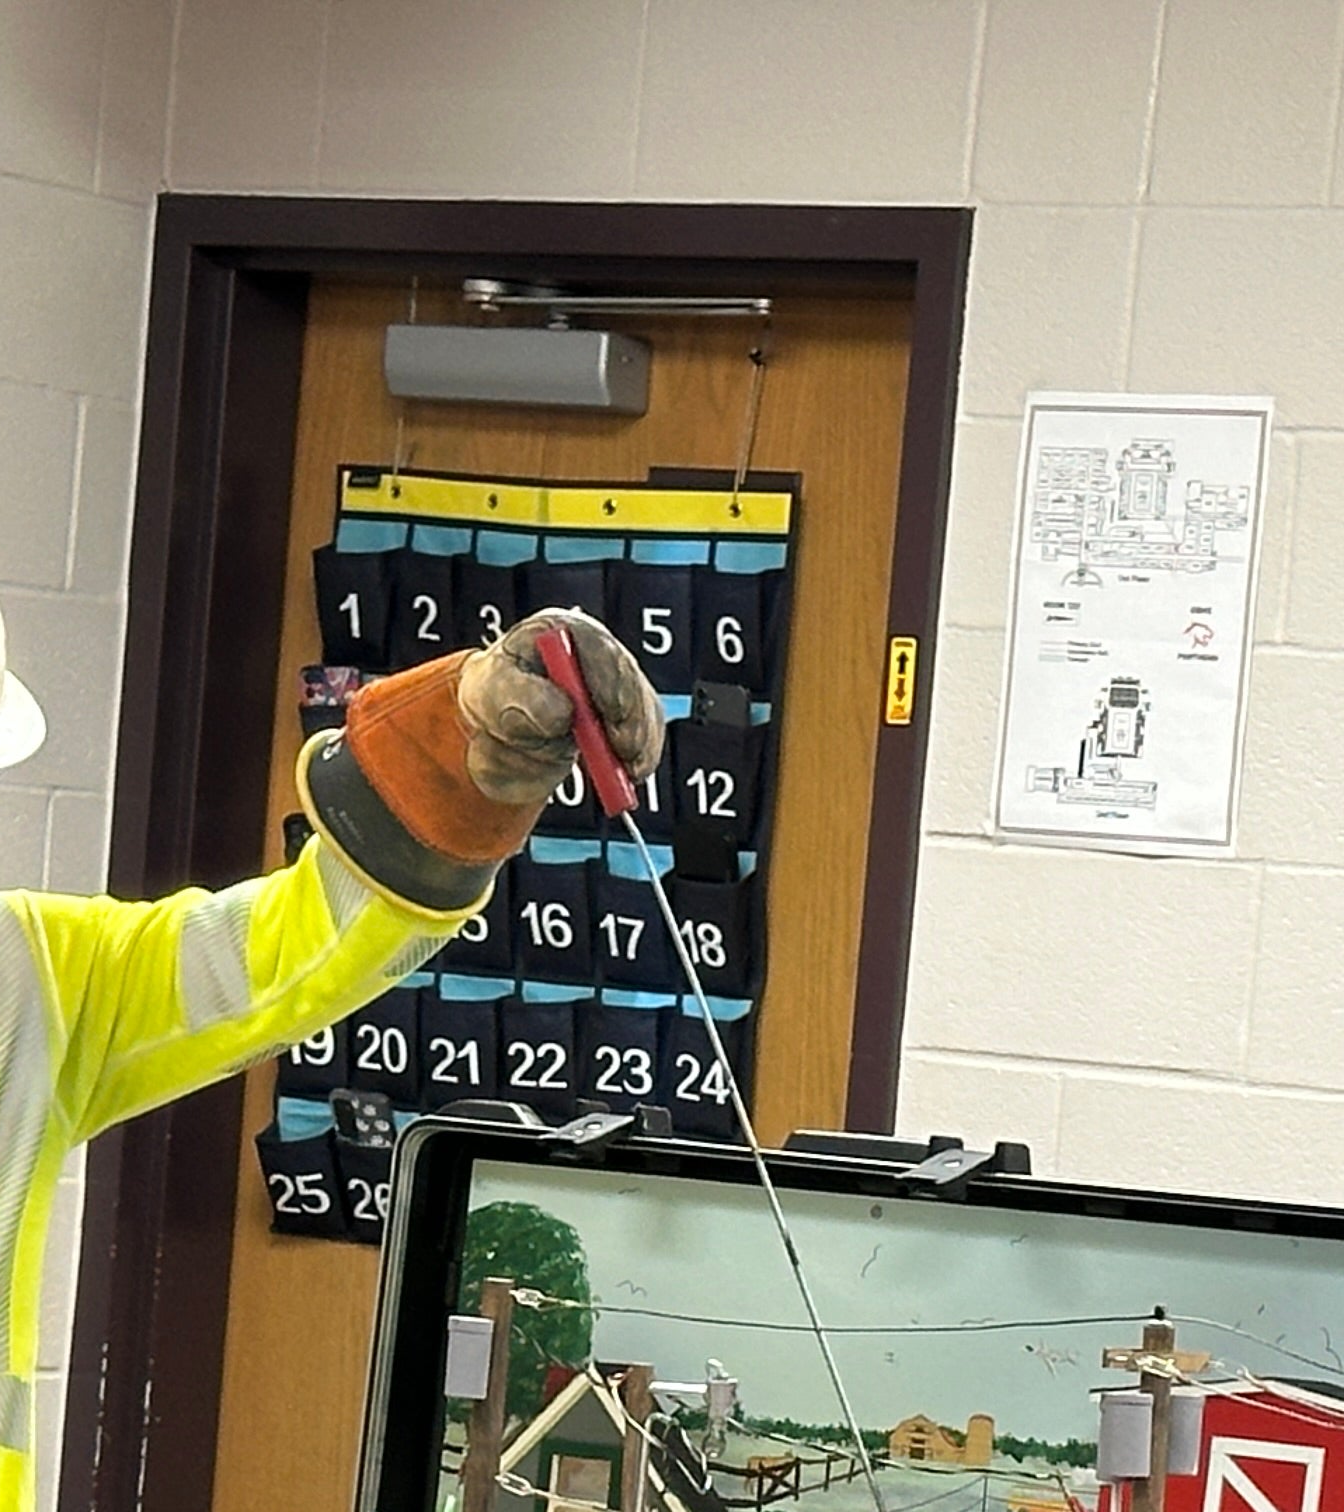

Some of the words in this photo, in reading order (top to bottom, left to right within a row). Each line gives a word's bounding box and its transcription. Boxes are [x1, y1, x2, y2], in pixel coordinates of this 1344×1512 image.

[339, 593, 360, 638] 1
[413, 595, 441, 641] 2
[479, 604, 504, 648] 3
[642, 607, 673, 655] 5
[715, 616, 745, 663] 6
[546, 763, 584, 806] 0
[686, 768, 737, 817] 12
[520, 901, 573, 948] 16
[599, 913, 645, 960] 17
[680, 919, 726, 967] 18
[357, 1024, 407, 1073] 20
[429, 1037, 480, 1085] 21
[508, 1042, 568, 1088] 22
[595, 1046, 653, 1095] 23
[676, 1053, 730, 1105] 24
[269, 1173, 331, 1214] 25
